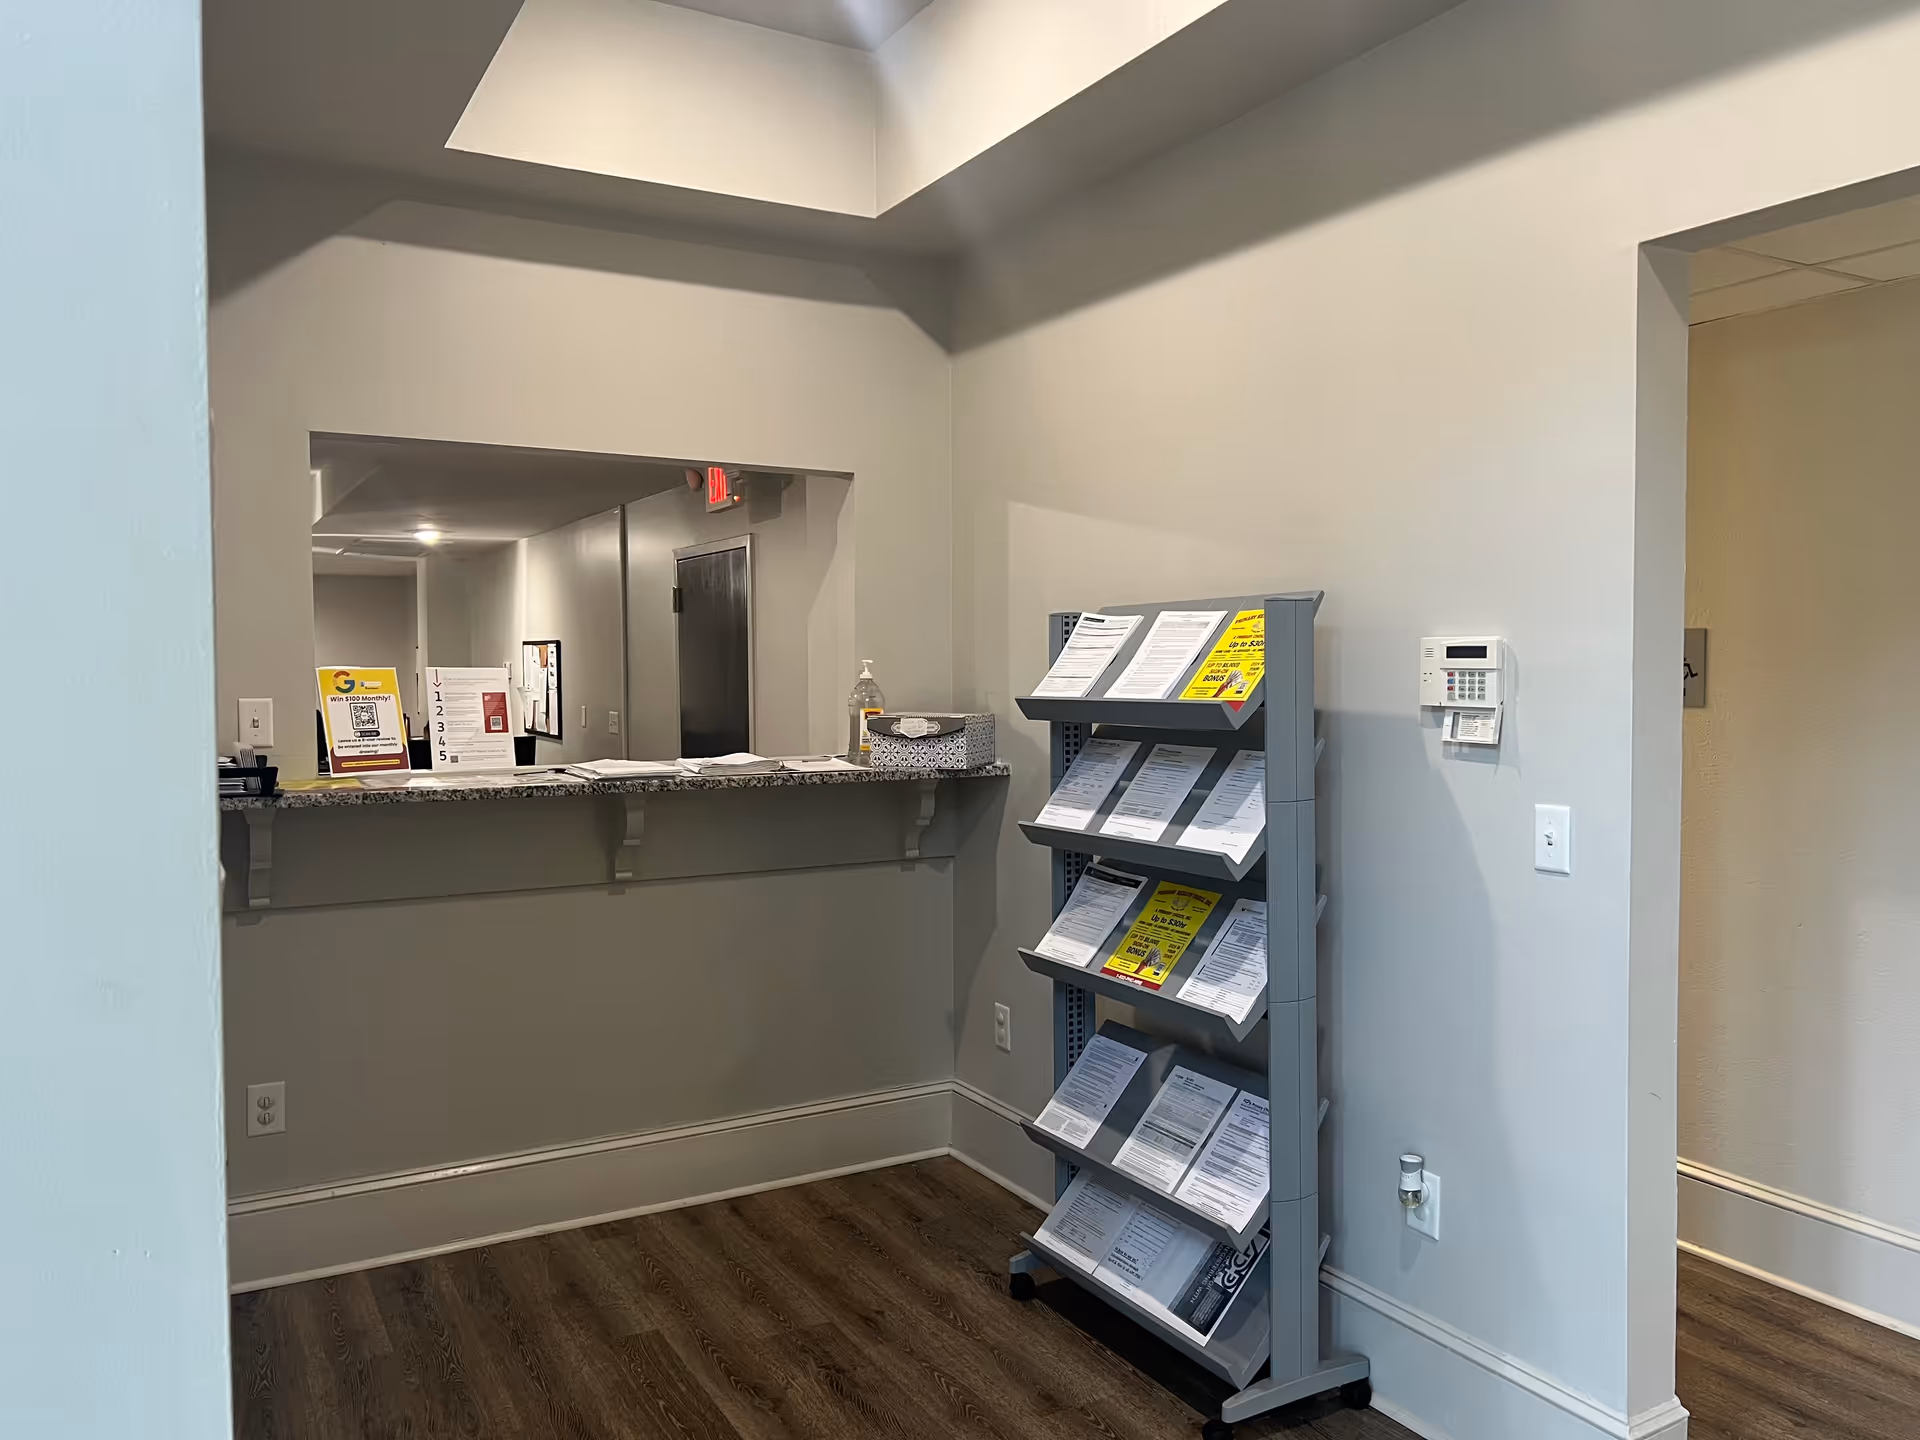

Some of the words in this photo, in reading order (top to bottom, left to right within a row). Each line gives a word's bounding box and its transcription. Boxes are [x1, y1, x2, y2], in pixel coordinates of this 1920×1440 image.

[1228, 641, 1239, 649] Up
[1248, 639, 1265, 647] $30
[1203, 674, 1225, 682] BONUS
[434, 691, 443, 702] 1
[436, 705, 444, 716] 2
[437, 721, 445, 732] 3
[438, 736, 446, 747] 4
[439, 750, 447, 761] 5
[1151, 914, 1160, 923] Up
[1160, 916, 1167, 924] to
[1126, 946, 1147, 957] BONUS
